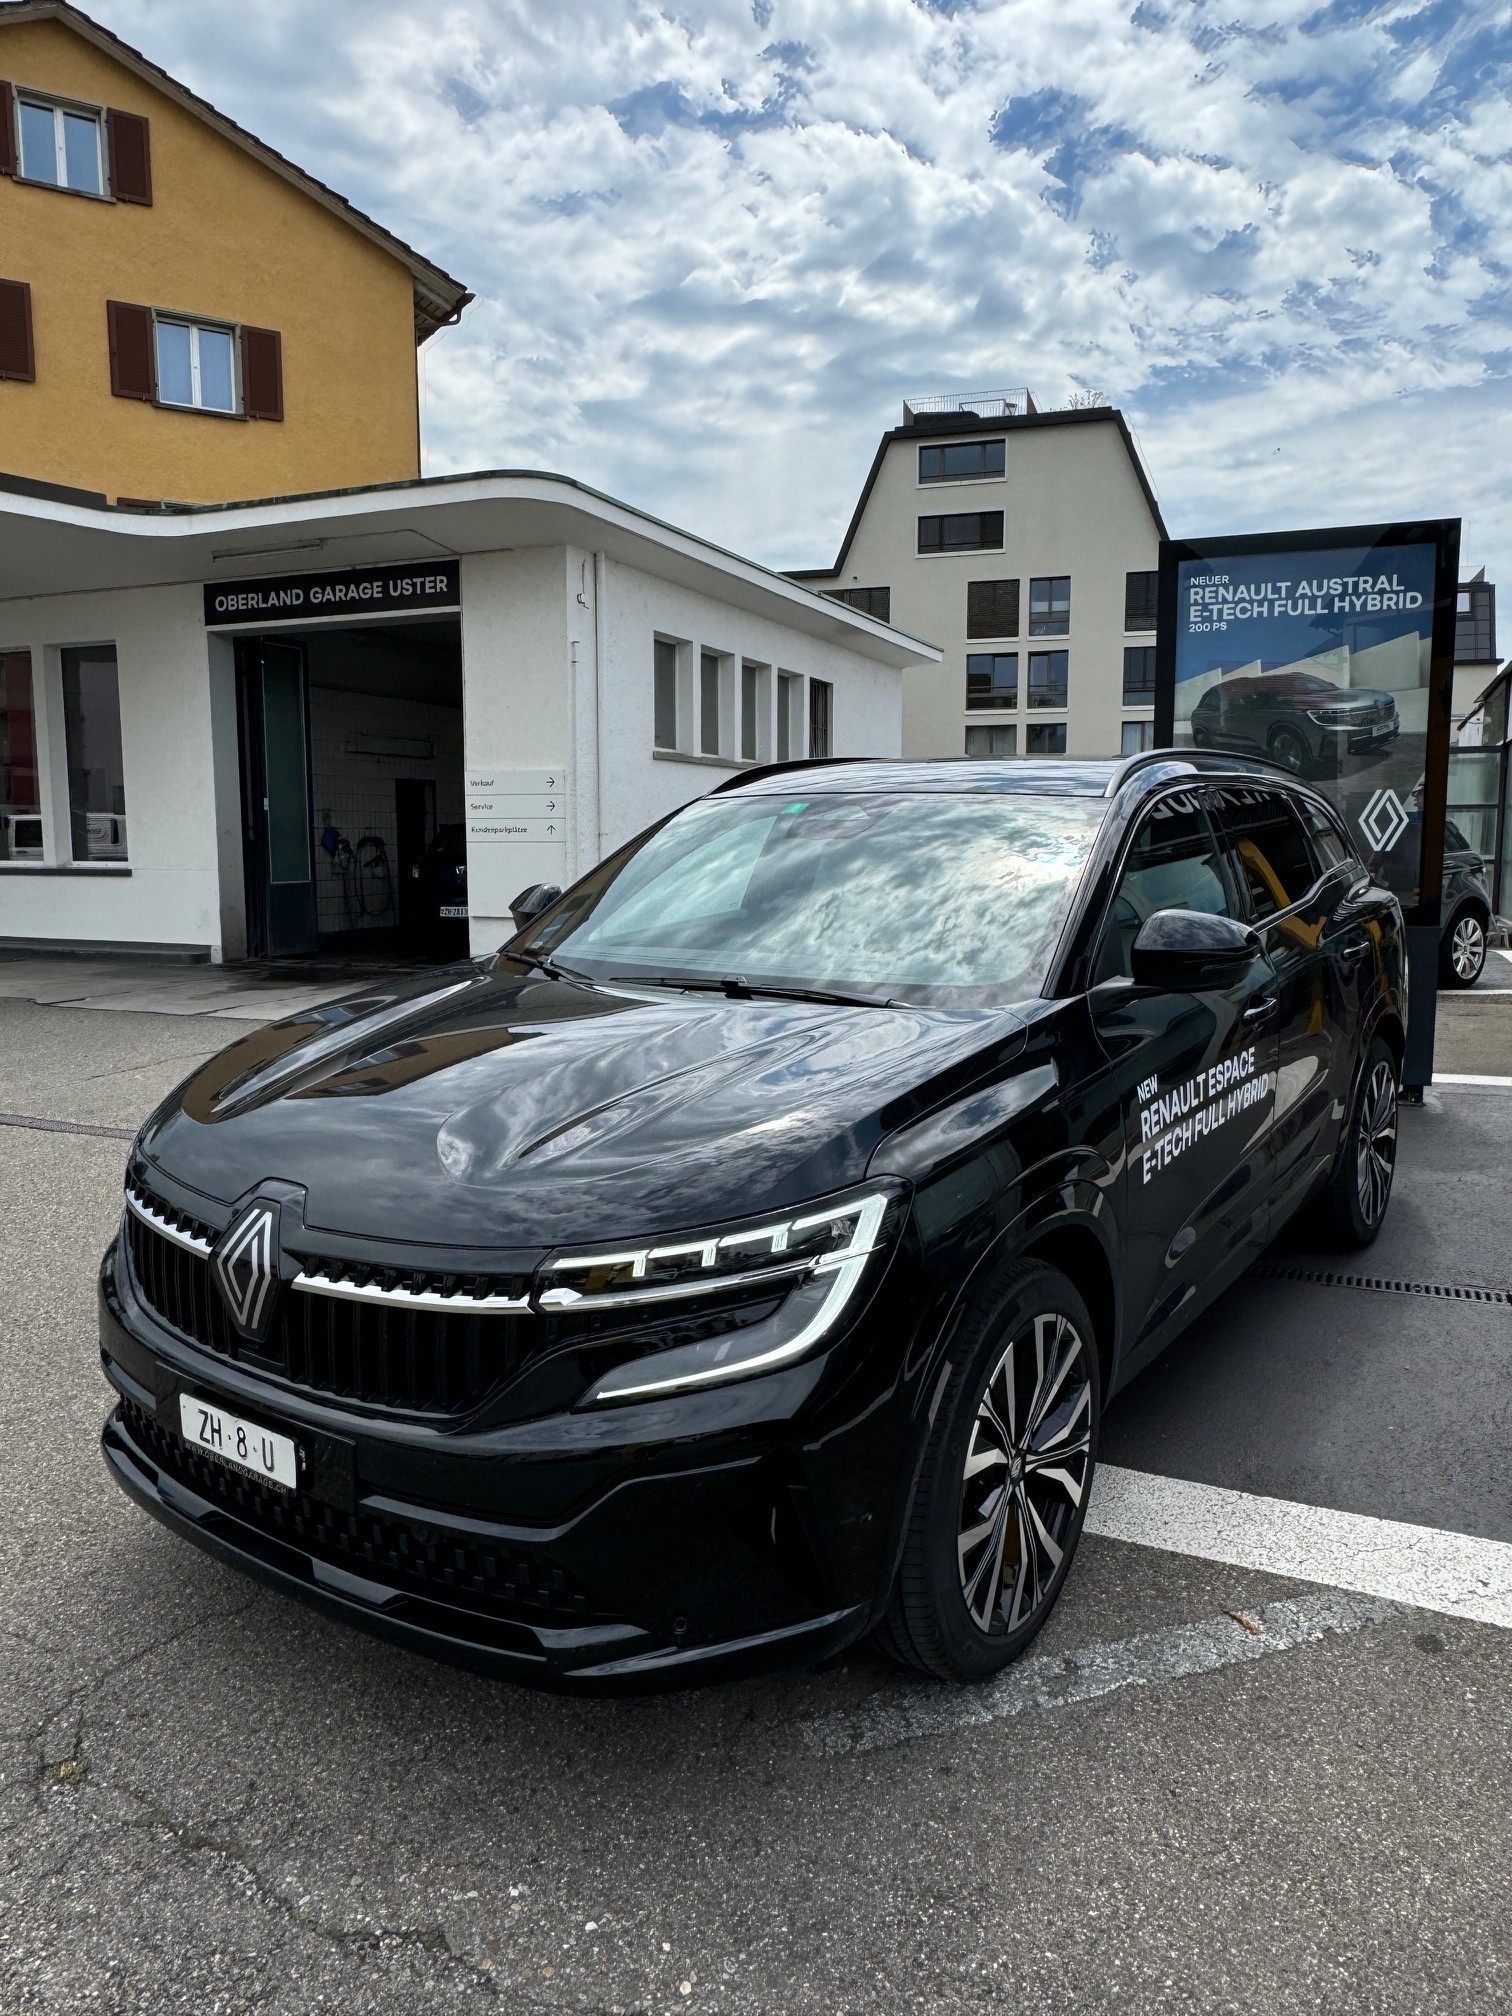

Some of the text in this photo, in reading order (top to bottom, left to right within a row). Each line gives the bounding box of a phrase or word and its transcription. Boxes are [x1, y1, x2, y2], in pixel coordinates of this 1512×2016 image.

[215, 575, 448, 612] OBERLAND GARAGE USTER
[1189, 573, 1405, 604] RENAULT AUSTRAL
[1190, 575, 1229, 586] NEUER
[1189, 591, 1423, 622] E-TECH FULL HYBRID
[1188, 622, 1228, 633] 200 PS
[469, 779, 495, 787] Verkauf
[470, 803, 494, 811] Service
[1136, 1073, 1158, 1104] NEW
[1140, 1046, 1255, 1144] RENAULT ESPACE
[1142, 1073, 1269, 1185] E-TECH FULL HYBRID
